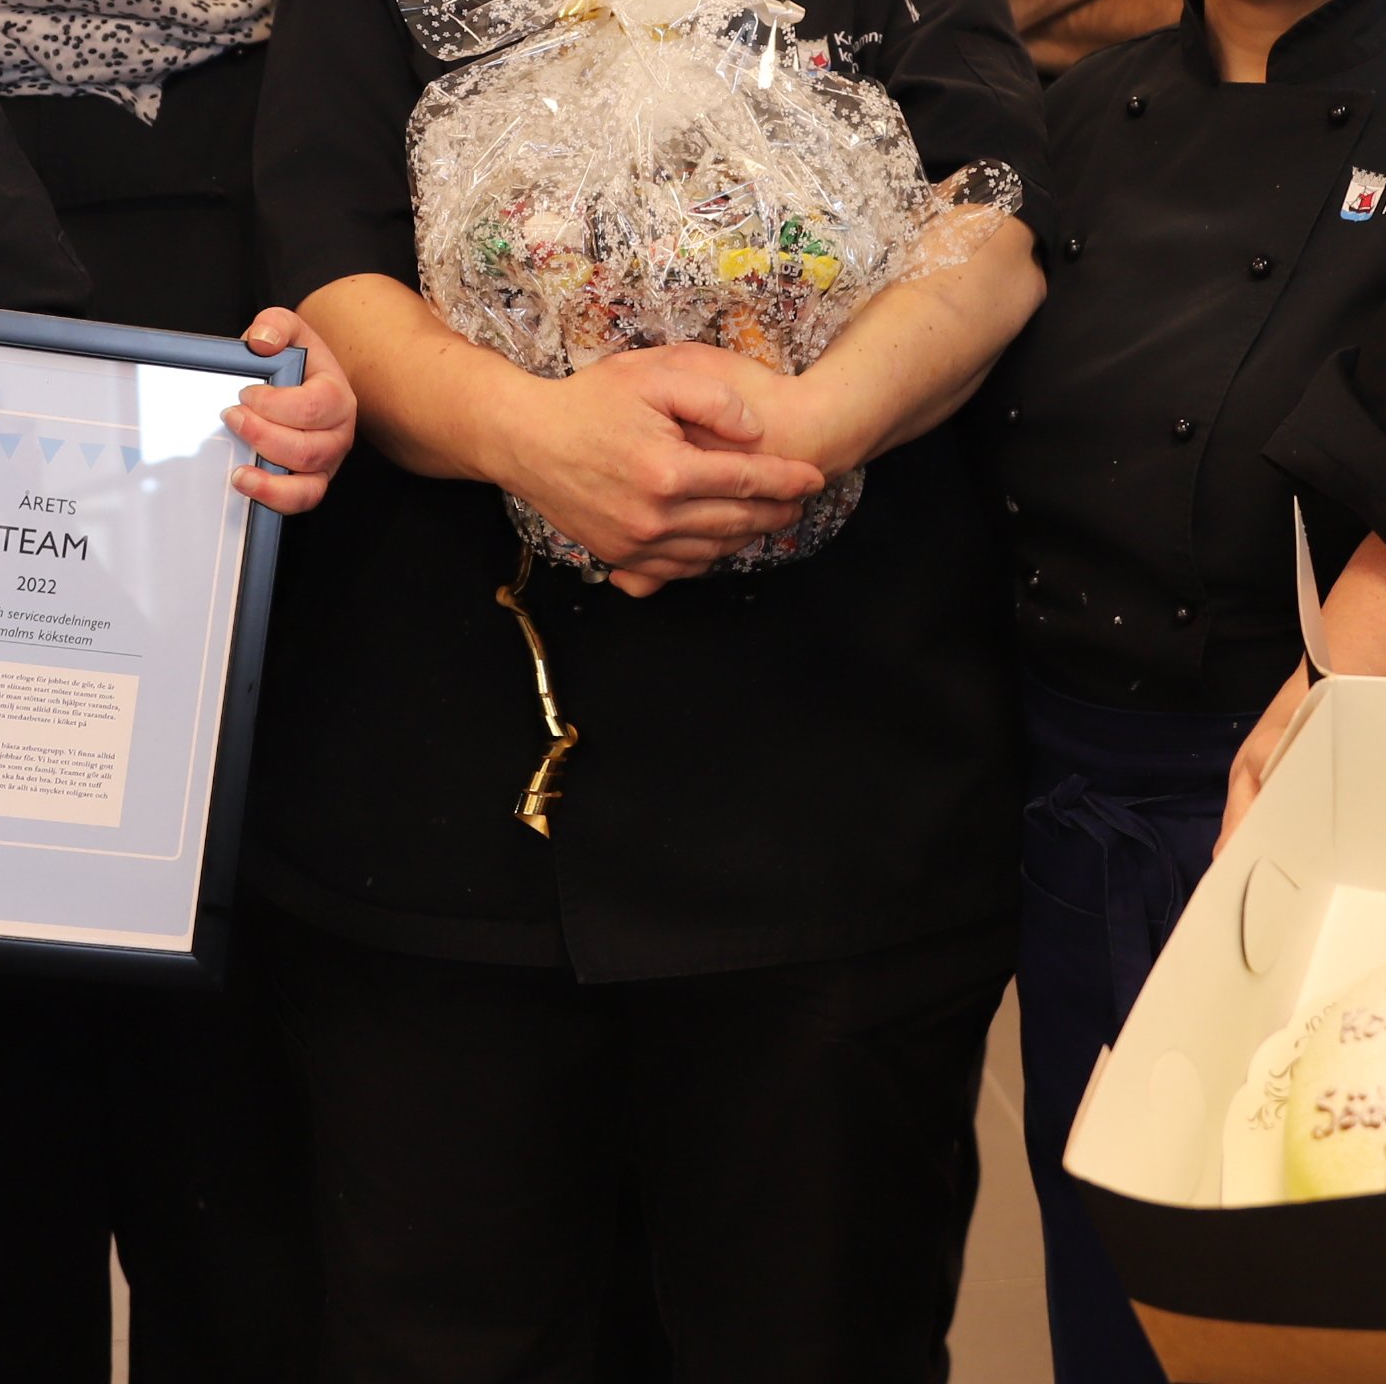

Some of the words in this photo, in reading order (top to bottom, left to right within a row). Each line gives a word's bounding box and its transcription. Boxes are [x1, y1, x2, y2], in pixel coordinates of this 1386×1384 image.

[18, 490, 77, 515] ÅRETS
[16, 576, 57, 595] 2022
[7, 610, 111, 632] serviceavdelningen
[38, 629, 93, 646] köksteam
[15, 674, 35, 683] eloge
[36, 675, 47, 683] för
[51, 688, 72, 696] möter
[52, 707, 70, 715] finns
[57, 717, 77, 726] köket
[77, 720, 87, 728] på
[1, 741, 20, 750] bästa
[68, 748, 76, 756] Vi
[77, 749, 95, 758] finns
[37, 755, 46, 763] Vi
[47, 756, 59, 764] har
[1, 772, 14, 780] ska
[54, 777, 68, 785] Det
[86, 771, 99, 779] gör
